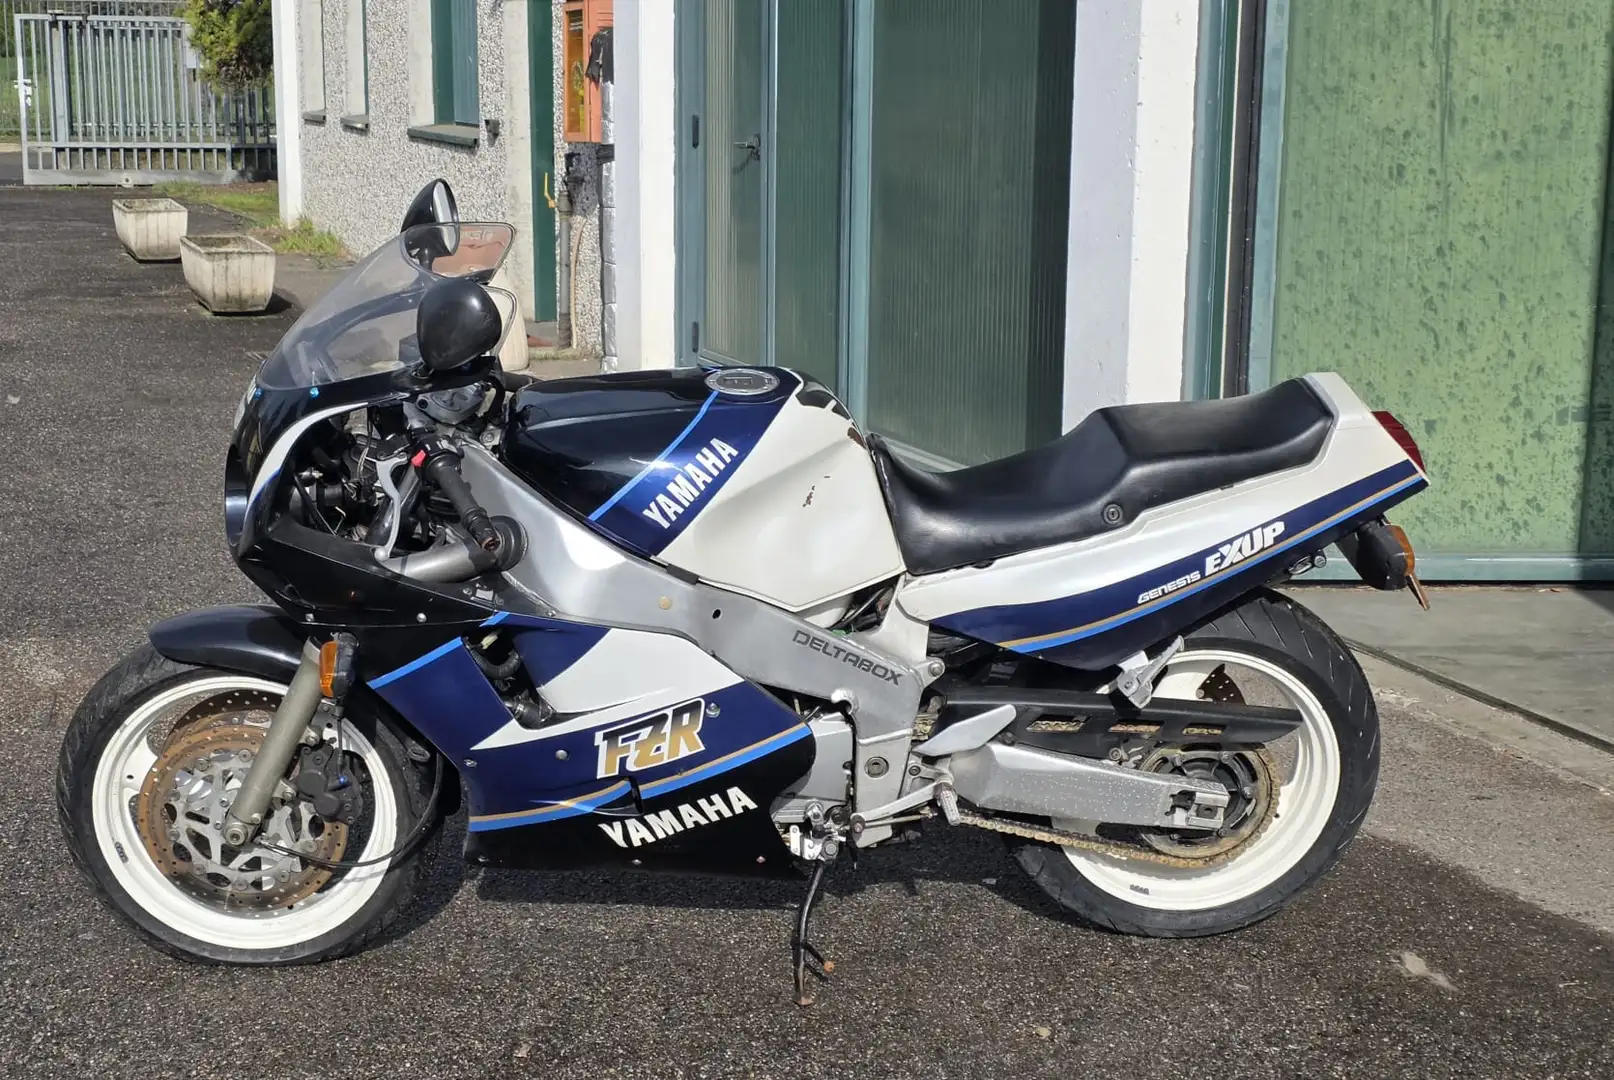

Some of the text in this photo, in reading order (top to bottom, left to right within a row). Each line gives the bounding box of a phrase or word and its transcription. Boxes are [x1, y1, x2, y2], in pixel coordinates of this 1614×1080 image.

[642, 437, 739, 530] YAMAHA
[1137, 520, 1286, 605] GENESIS EXUP
[792, 629, 903, 686] DELTABOX
[594, 697, 706, 780] FZR
[598, 786, 759, 848] YAMAHA
